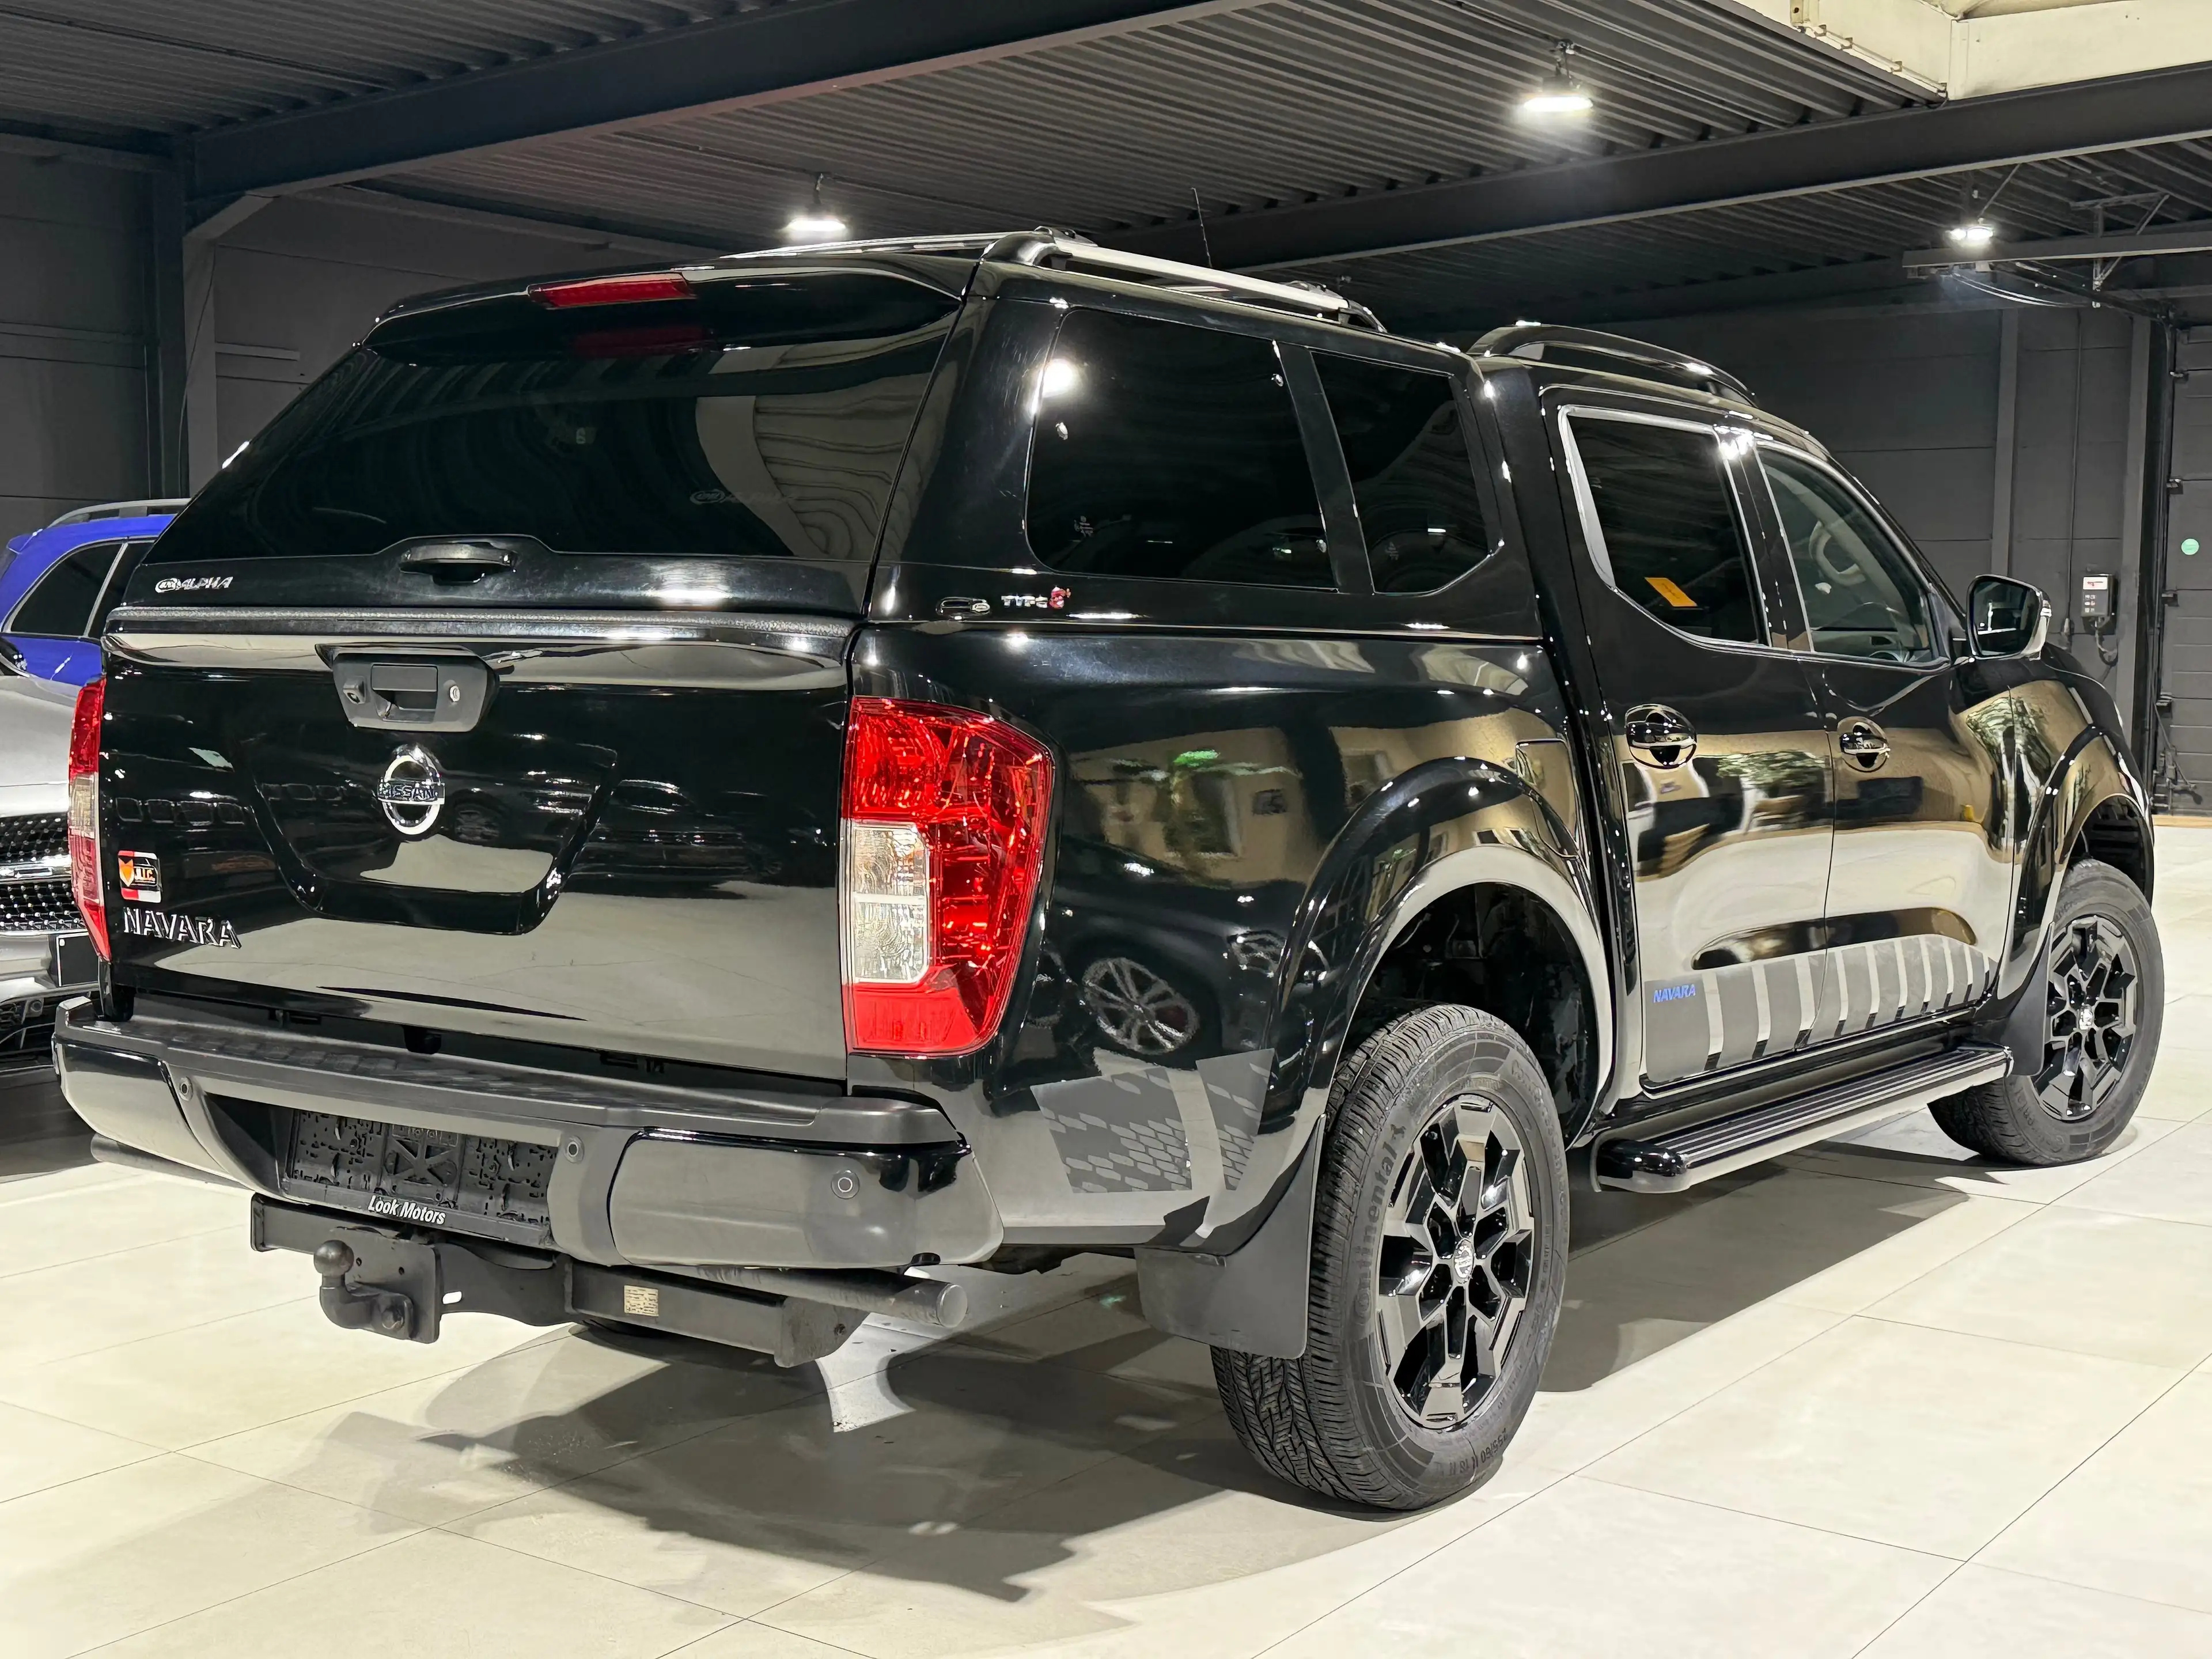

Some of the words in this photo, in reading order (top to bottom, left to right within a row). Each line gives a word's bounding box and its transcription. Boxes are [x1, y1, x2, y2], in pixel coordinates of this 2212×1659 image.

[181, 576, 234, 590] ALPHA
[378, 782, 439, 802] NISSAN
[123, 907, 242, 949] NAVARA
[1653, 984, 1696, 1003] NAVARA
[368, 1195, 399, 1216] Look
[399, 1201, 446, 1225] Motors
[1354, 1141, 1397, 1316] Continental
